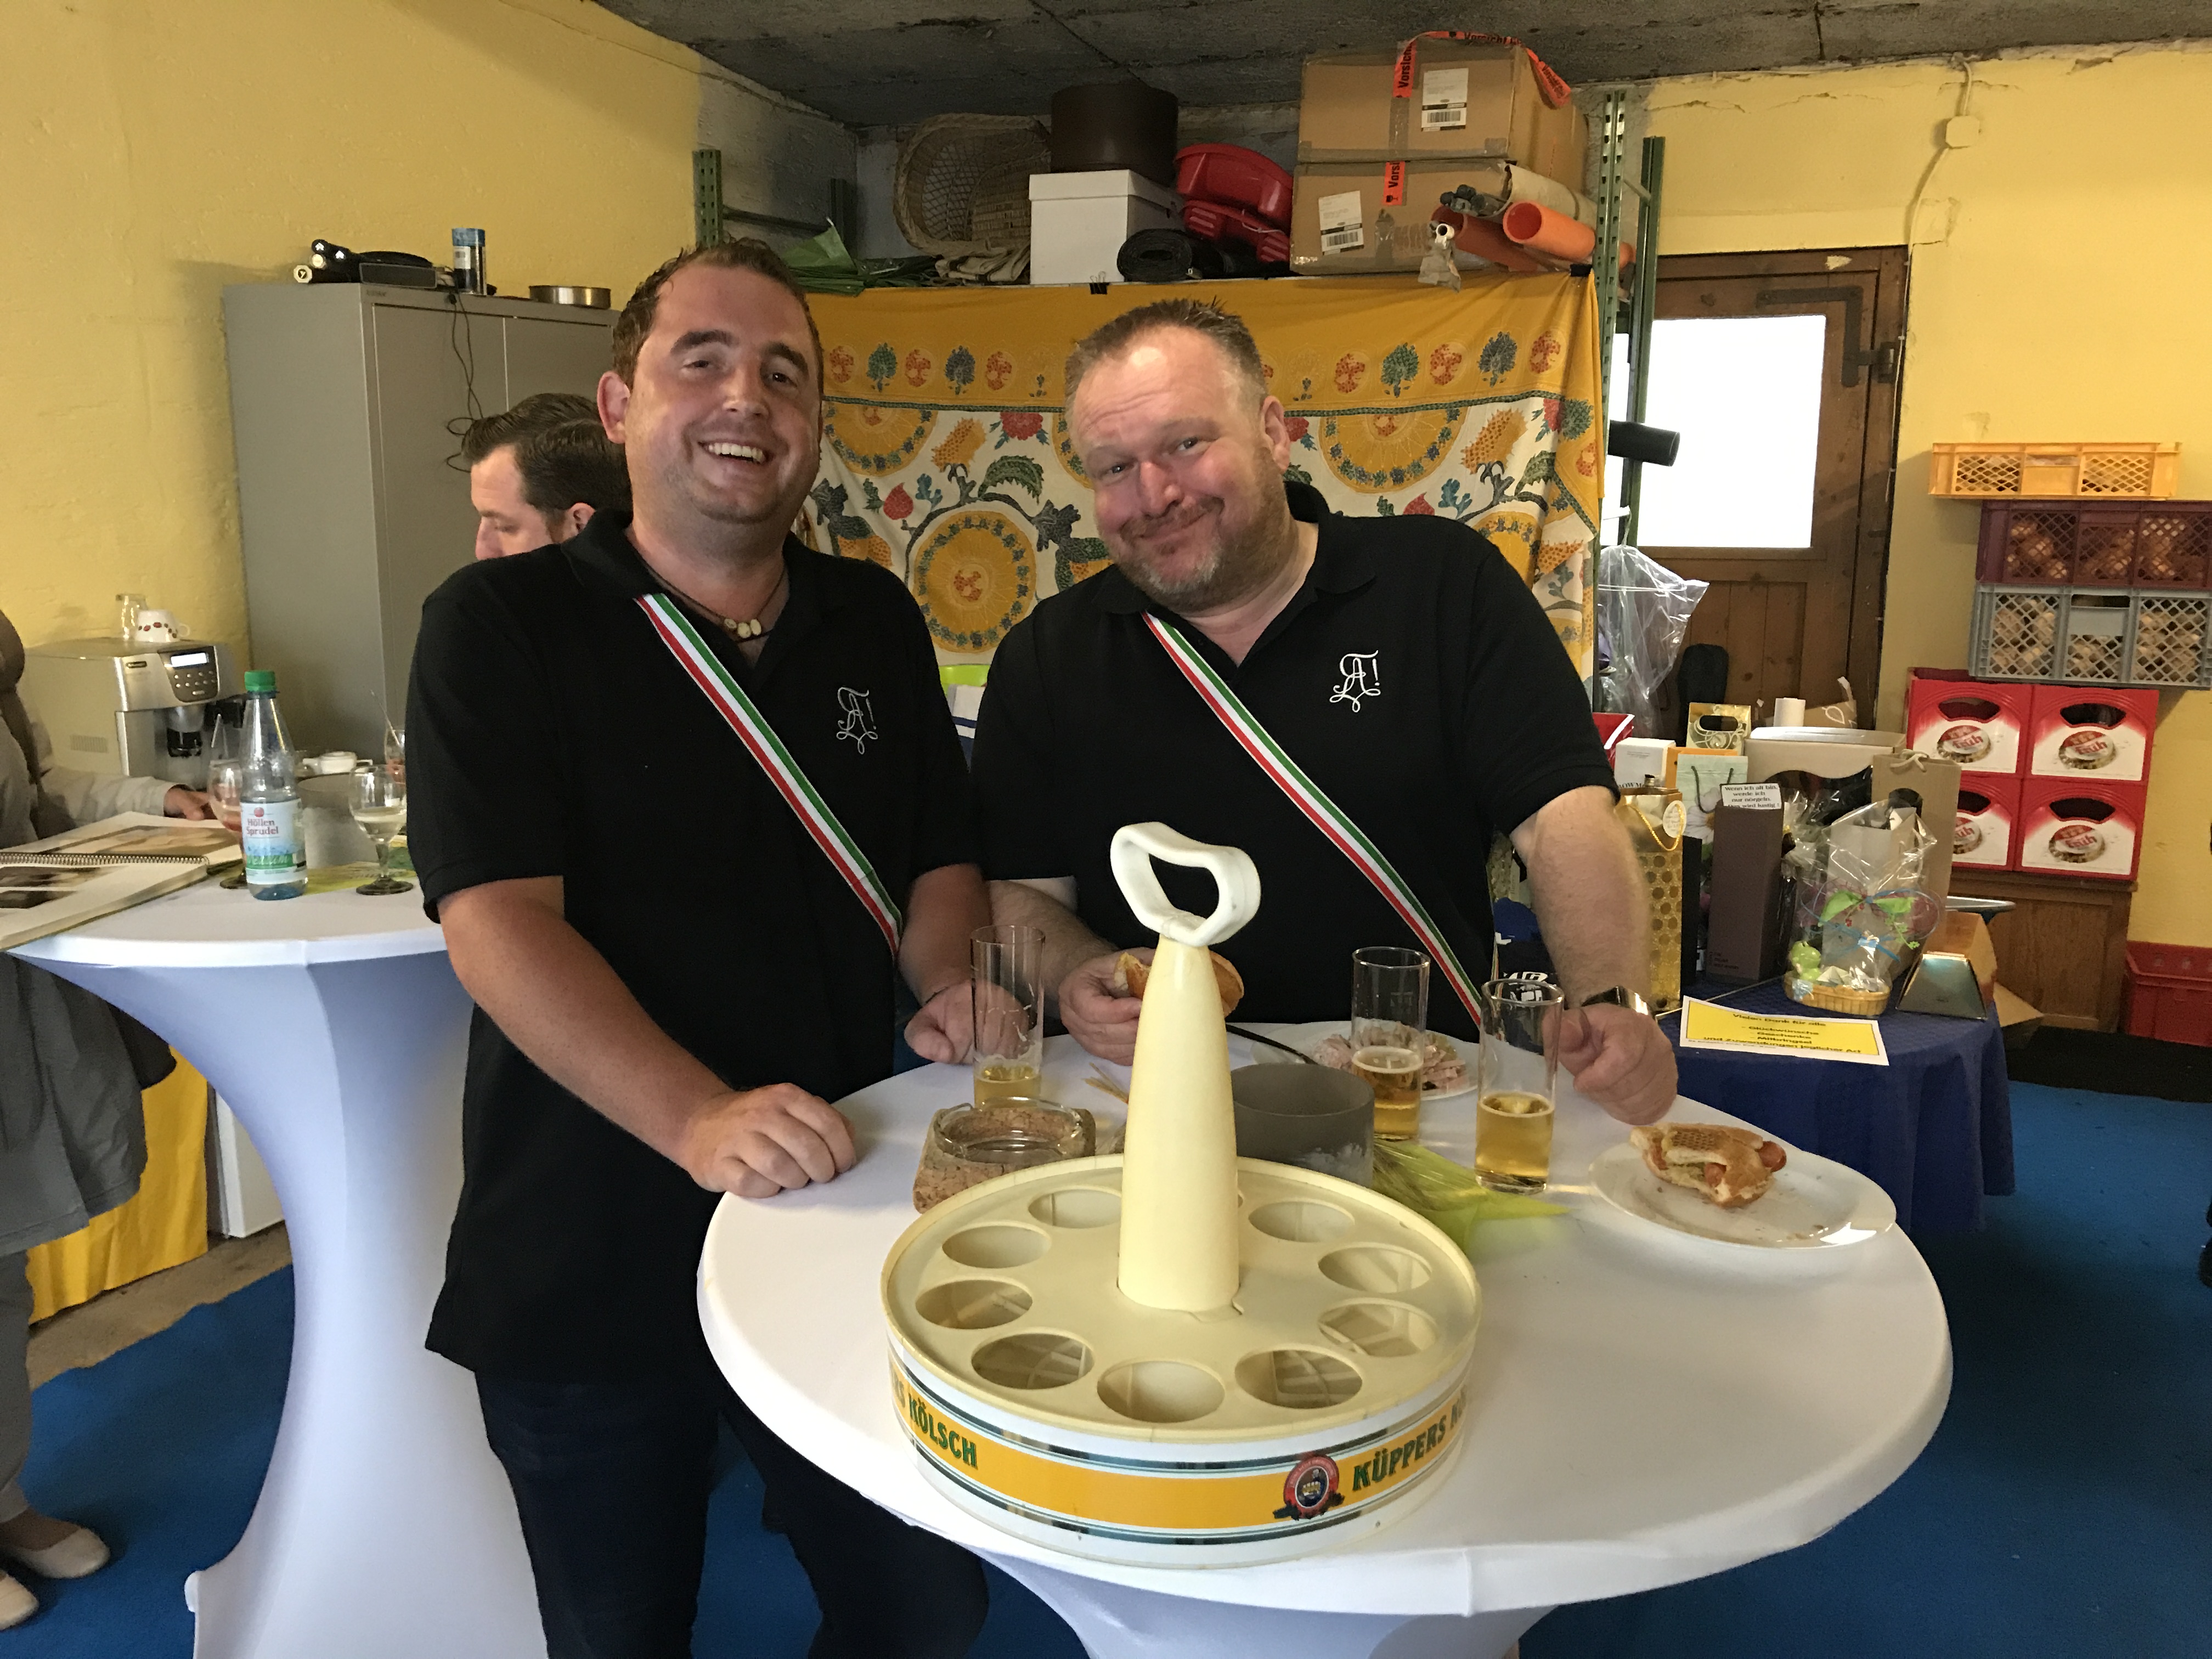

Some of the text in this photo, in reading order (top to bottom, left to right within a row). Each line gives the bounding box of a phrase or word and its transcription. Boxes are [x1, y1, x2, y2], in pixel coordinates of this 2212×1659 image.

[246, 826, 279, 836] Sprudel
[909, 1392, 978, 1470] KÖLSCH
[1352, 1415, 1447, 1492] KÜPPERS
